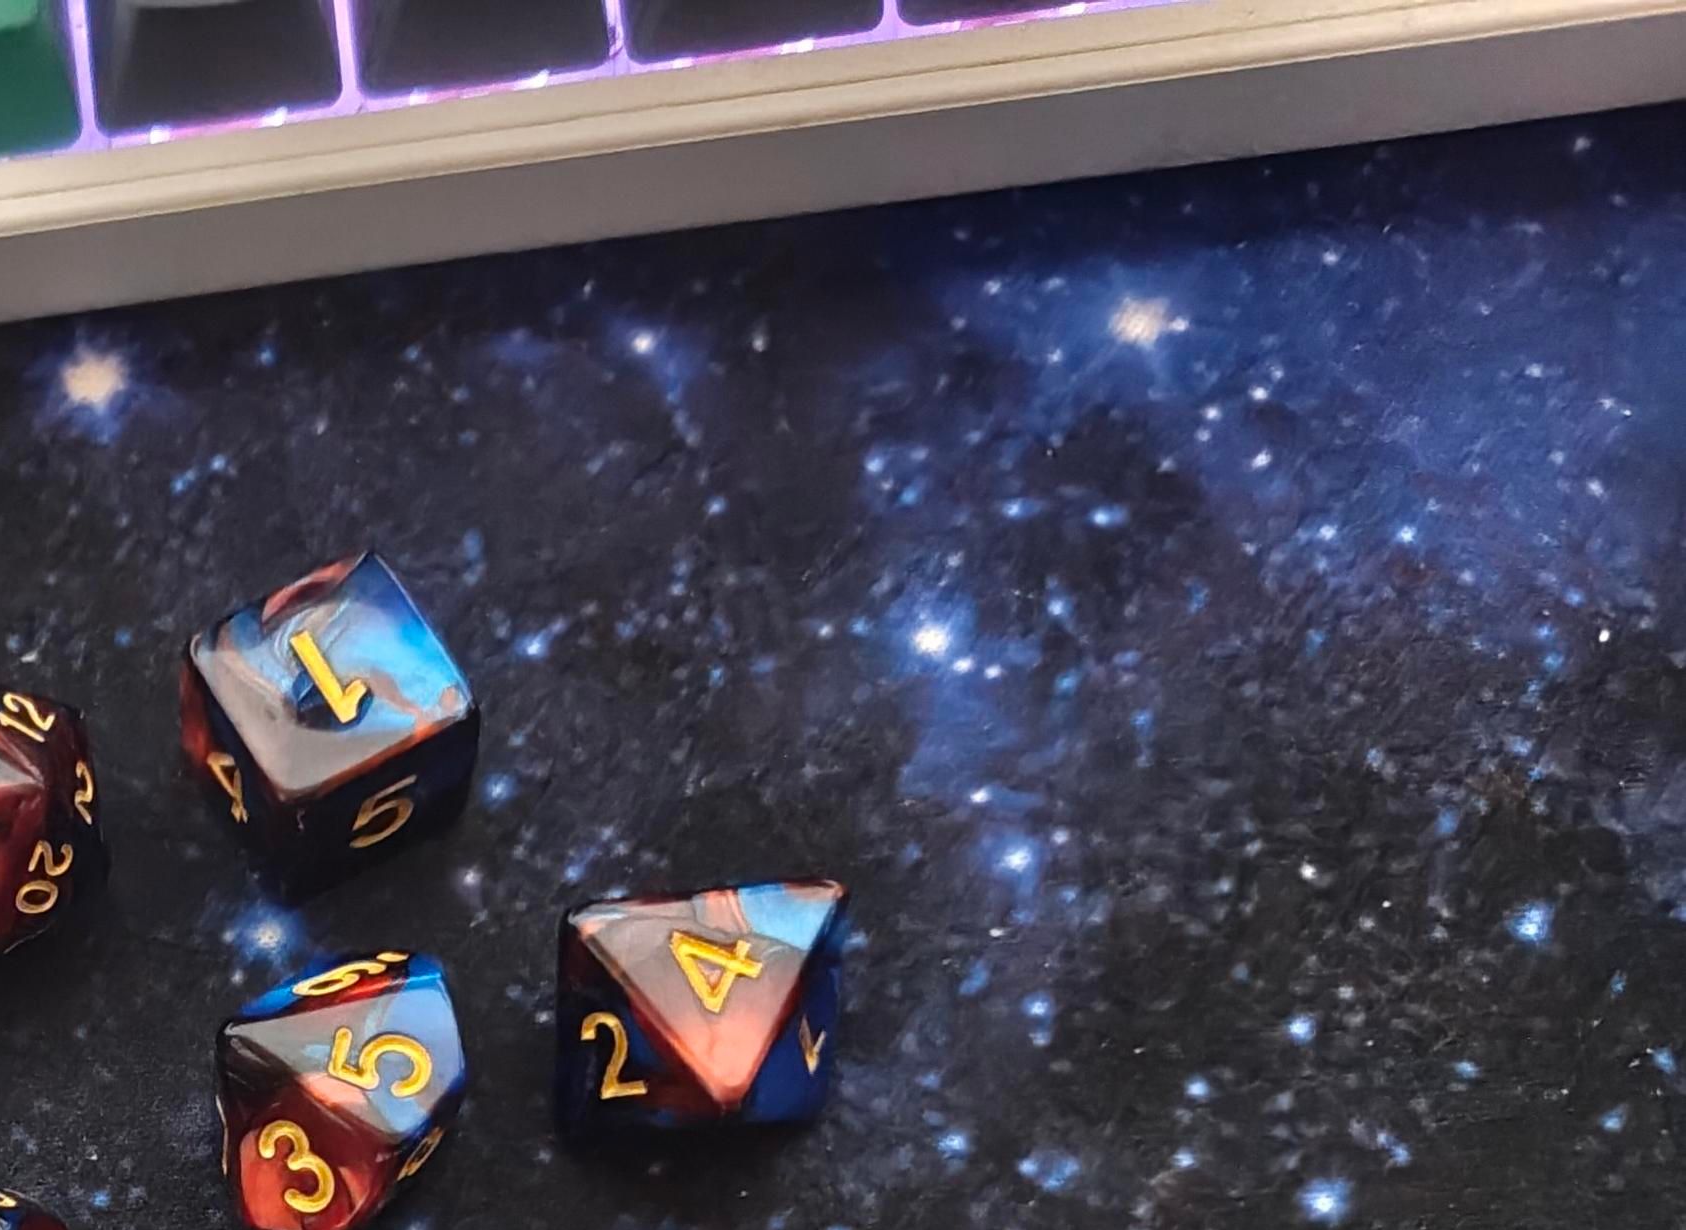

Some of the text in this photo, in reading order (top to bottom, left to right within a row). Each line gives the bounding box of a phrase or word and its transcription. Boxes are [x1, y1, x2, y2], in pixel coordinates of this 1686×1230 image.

[290, 630, 367, 724] 1
[349, 774, 418, 848] 5
[16, 840, 74, 914] 20
[669, 930, 763, 1014] 4
[327, 1026, 432, 1098] 5
[580, 1011, 648, 1100] 2
[258, 1120, 335, 1214] 3
